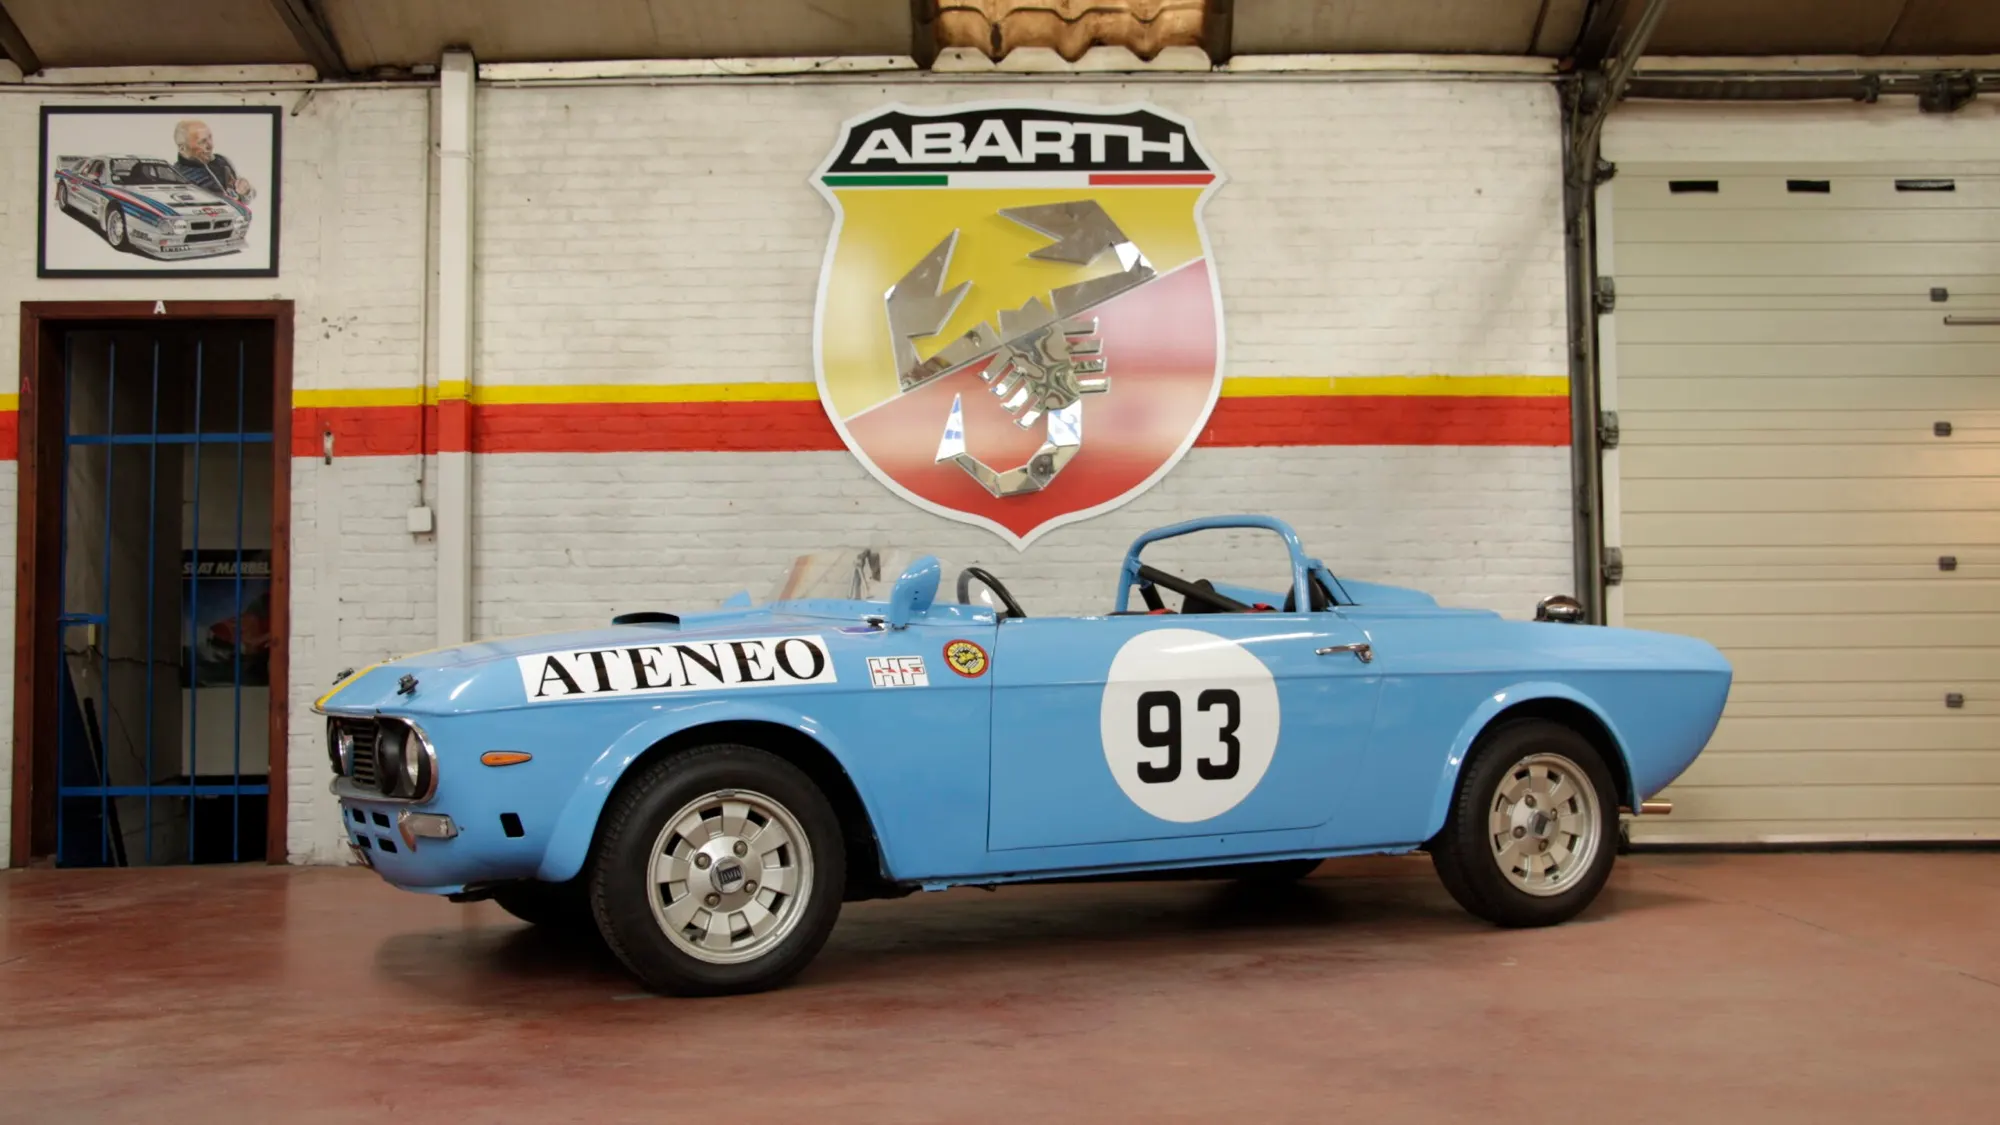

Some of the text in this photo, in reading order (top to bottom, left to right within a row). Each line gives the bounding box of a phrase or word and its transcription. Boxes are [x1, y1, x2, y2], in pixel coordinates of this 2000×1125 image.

[850, 119, 1184, 164] ABARTH
[154, 300, 166, 314] A
[534, 638, 825, 697] ATENEO
[868, 657, 925, 686] HF
[1137, 688, 1240, 784] 93
